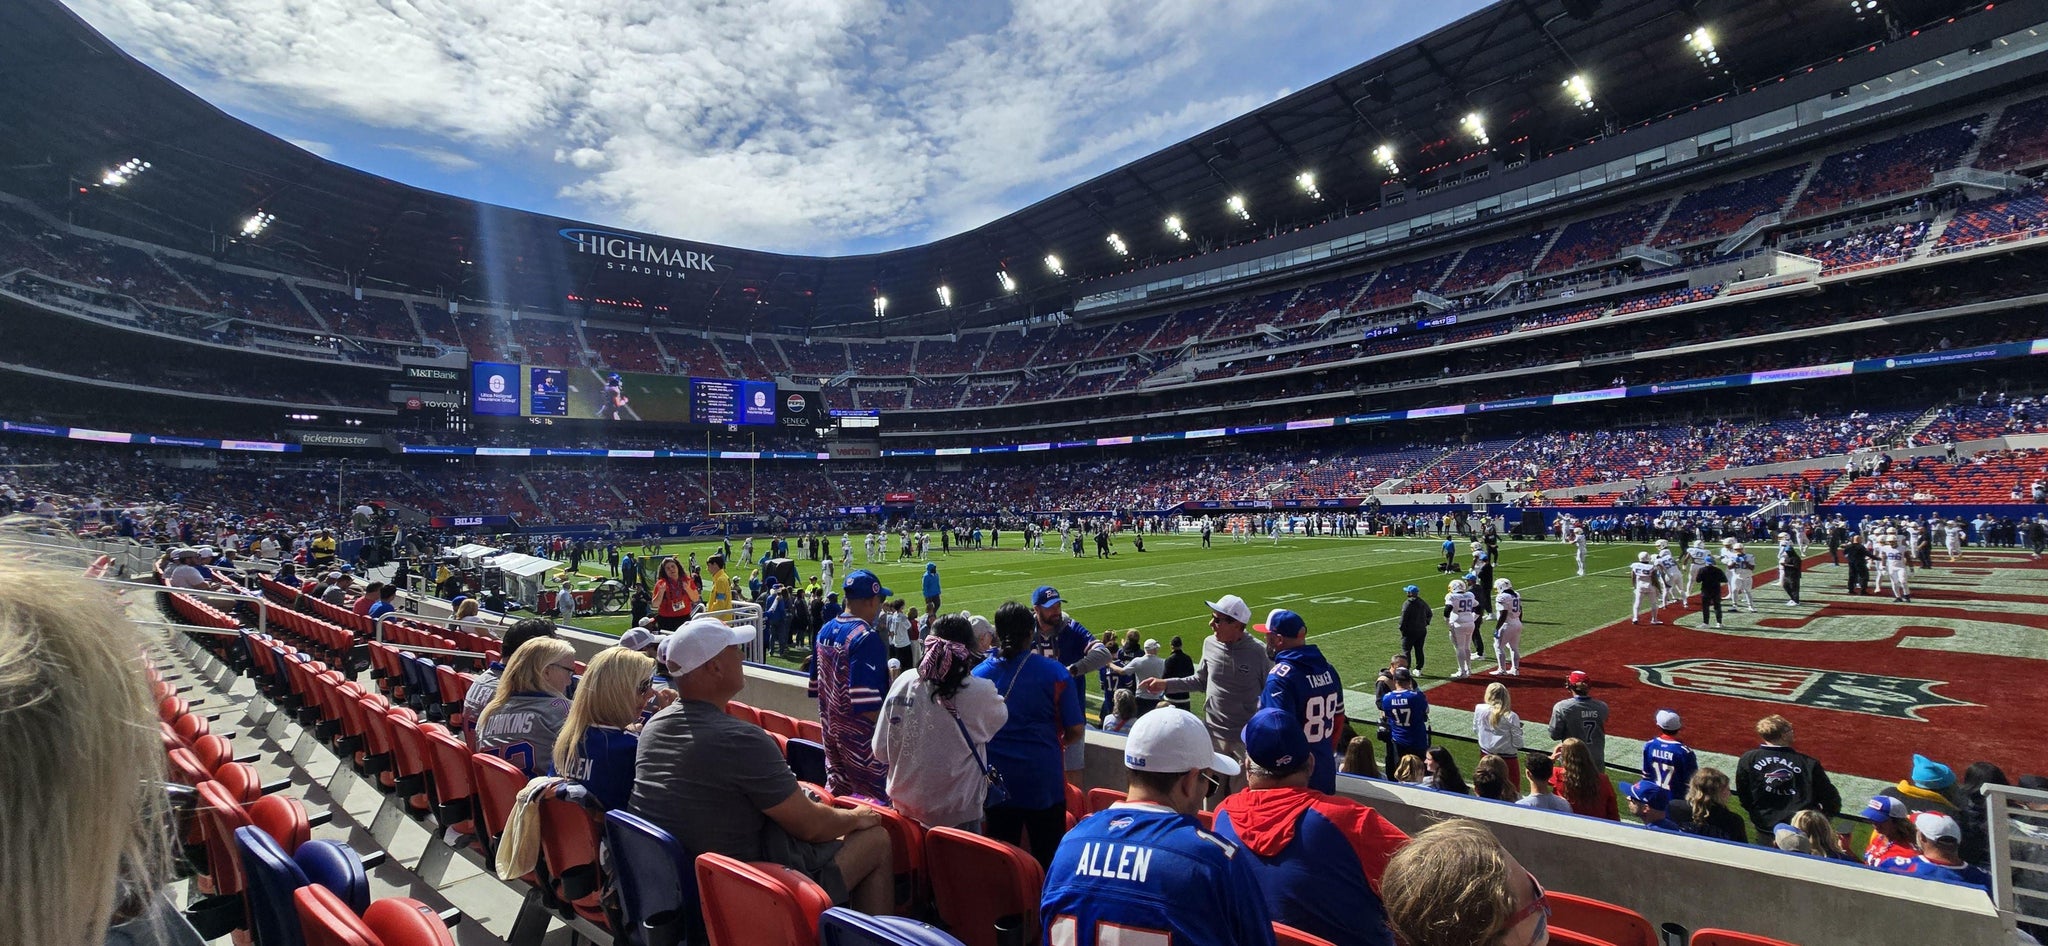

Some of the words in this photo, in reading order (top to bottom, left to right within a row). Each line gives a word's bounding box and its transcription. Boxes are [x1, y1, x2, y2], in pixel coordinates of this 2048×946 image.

[578, 233, 715, 273] HIGHMARK
[607, 262, 686, 280] STADIUM
[1895, 358, 1912, 366] Utica
[1912, 355, 1939, 364] National
[1940, 352, 1973, 361] Insurance
[1973, 350, 1996, 359] Group
[410, 368, 434, 378] M&T
[433, 370, 456, 379] Bank
[424, 401, 459, 409] TOYOTA
[782, 417, 810, 425] SENECA
[302, 432, 369, 445] ticketmaster
[836, 447, 871, 456] verizon
[1661, 510, 1685, 518] HOME
[454, 517, 483, 526] BILLS
[1458, 599, 1473, 612] 99
[1512, 599, 1521, 612] 9
[1306, 670, 1334, 689] TASKER
[1391, 698, 1409, 706] ALLEN
[1303, 691, 1338, 743] 89
[1391, 708, 1412, 727] 17
[1581, 710, 1598, 719] DAVIS
[484, 712, 535, 737] DAWKINS
[1583, 721, 1596, 745] 7
[1126, 754, 1147, 768] BILLS
[1652, 748, 1674, 761] ALLEN
[1753, 756, 1802, 774] BUFFALO
[1652, 761, 1675, 790] 17
[1765, 785, 1796, 797] BILLS
[1075, 841, 1153, 884] ALLEN
